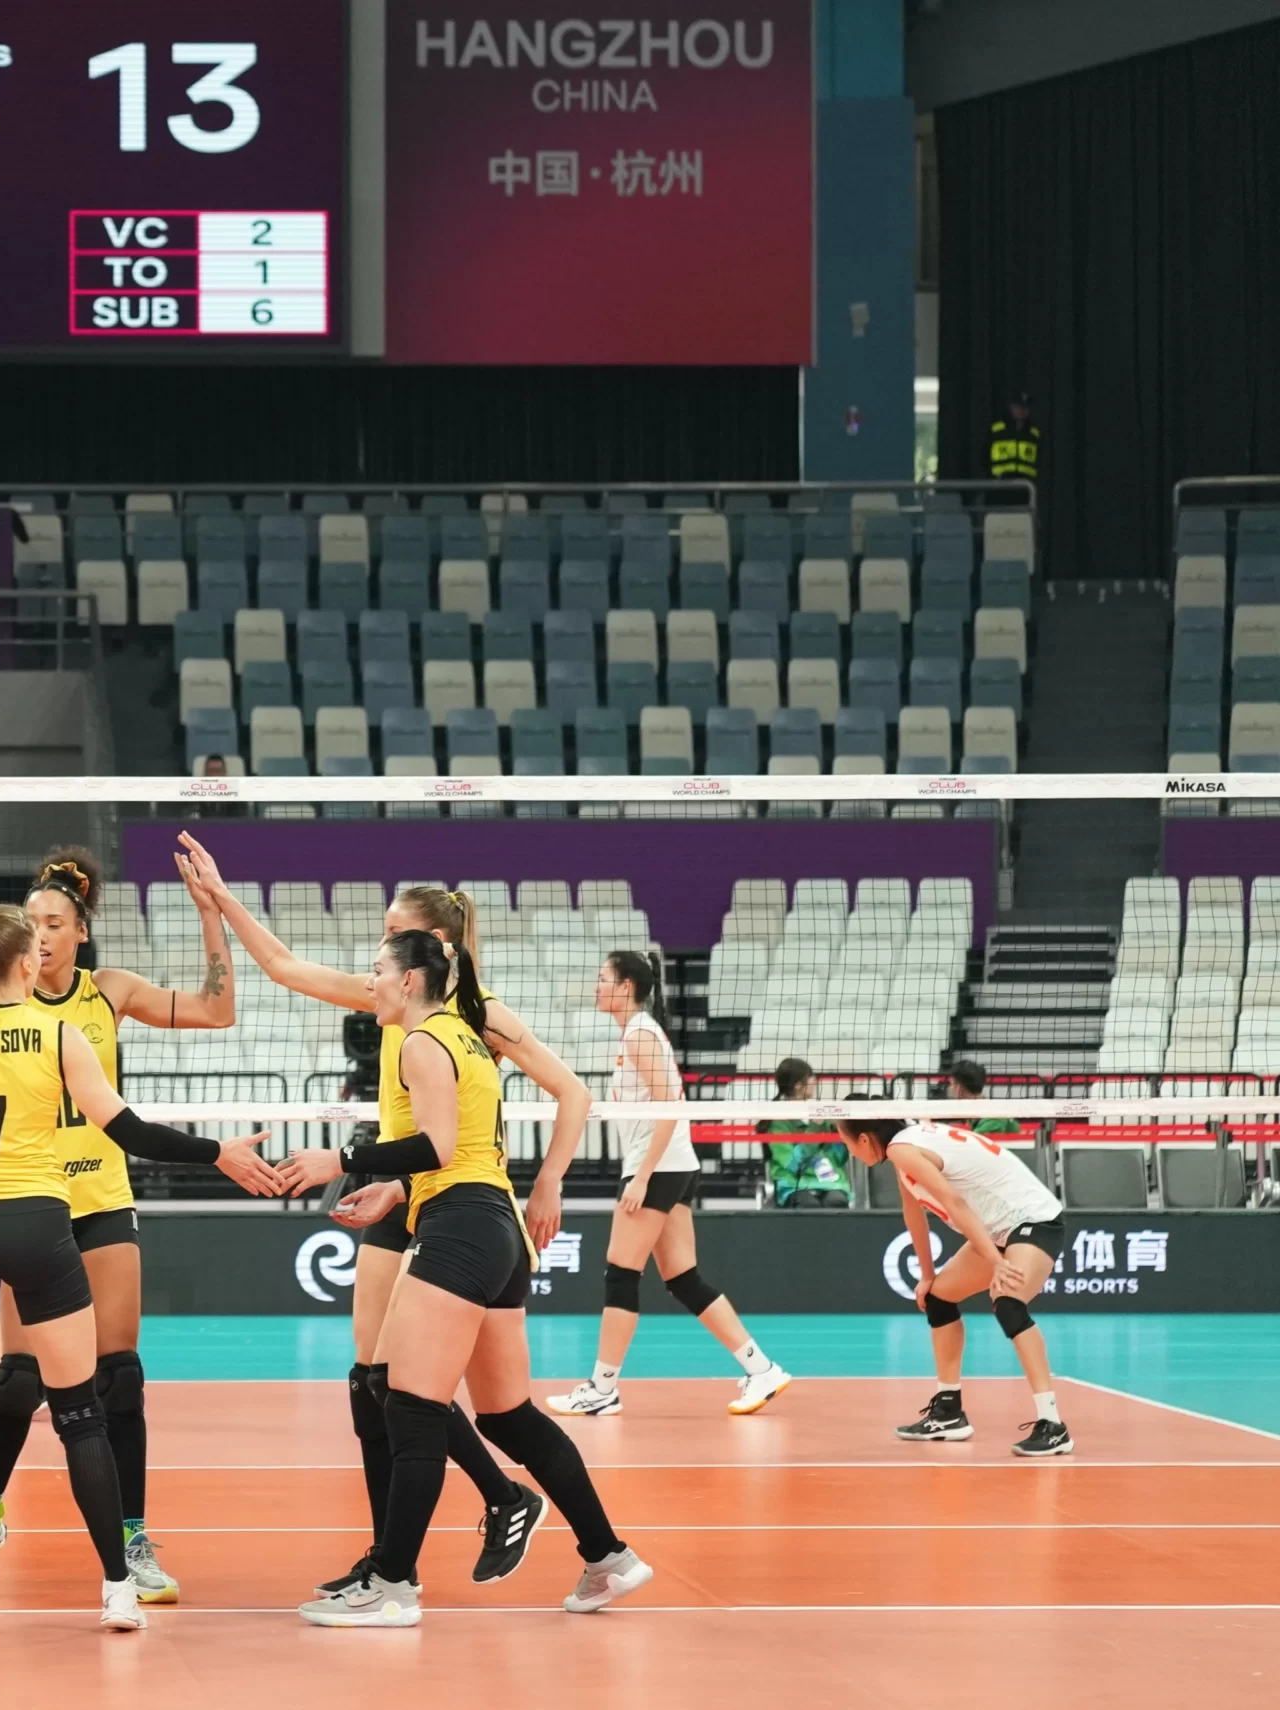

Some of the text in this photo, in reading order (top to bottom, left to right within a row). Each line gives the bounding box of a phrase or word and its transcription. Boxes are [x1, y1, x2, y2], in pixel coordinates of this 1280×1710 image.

[415, 19, 774, 68] HANGZHOU
[88, 42, 261, 154] 13
[531, 79, 657, 112] CHINA
[488, 149, 703, 197] 中国·杭州
[102, 216, 169, 249] VC
[250, 219, 273, 246] 2
[103, 256, 167, 288] TO
[254, 260, 270, 285] 1
[92, 297, 179, 329] SUB
[250, 299, 274, 325] 6
[1064, 1278, 1139, 1294] SPORTS
